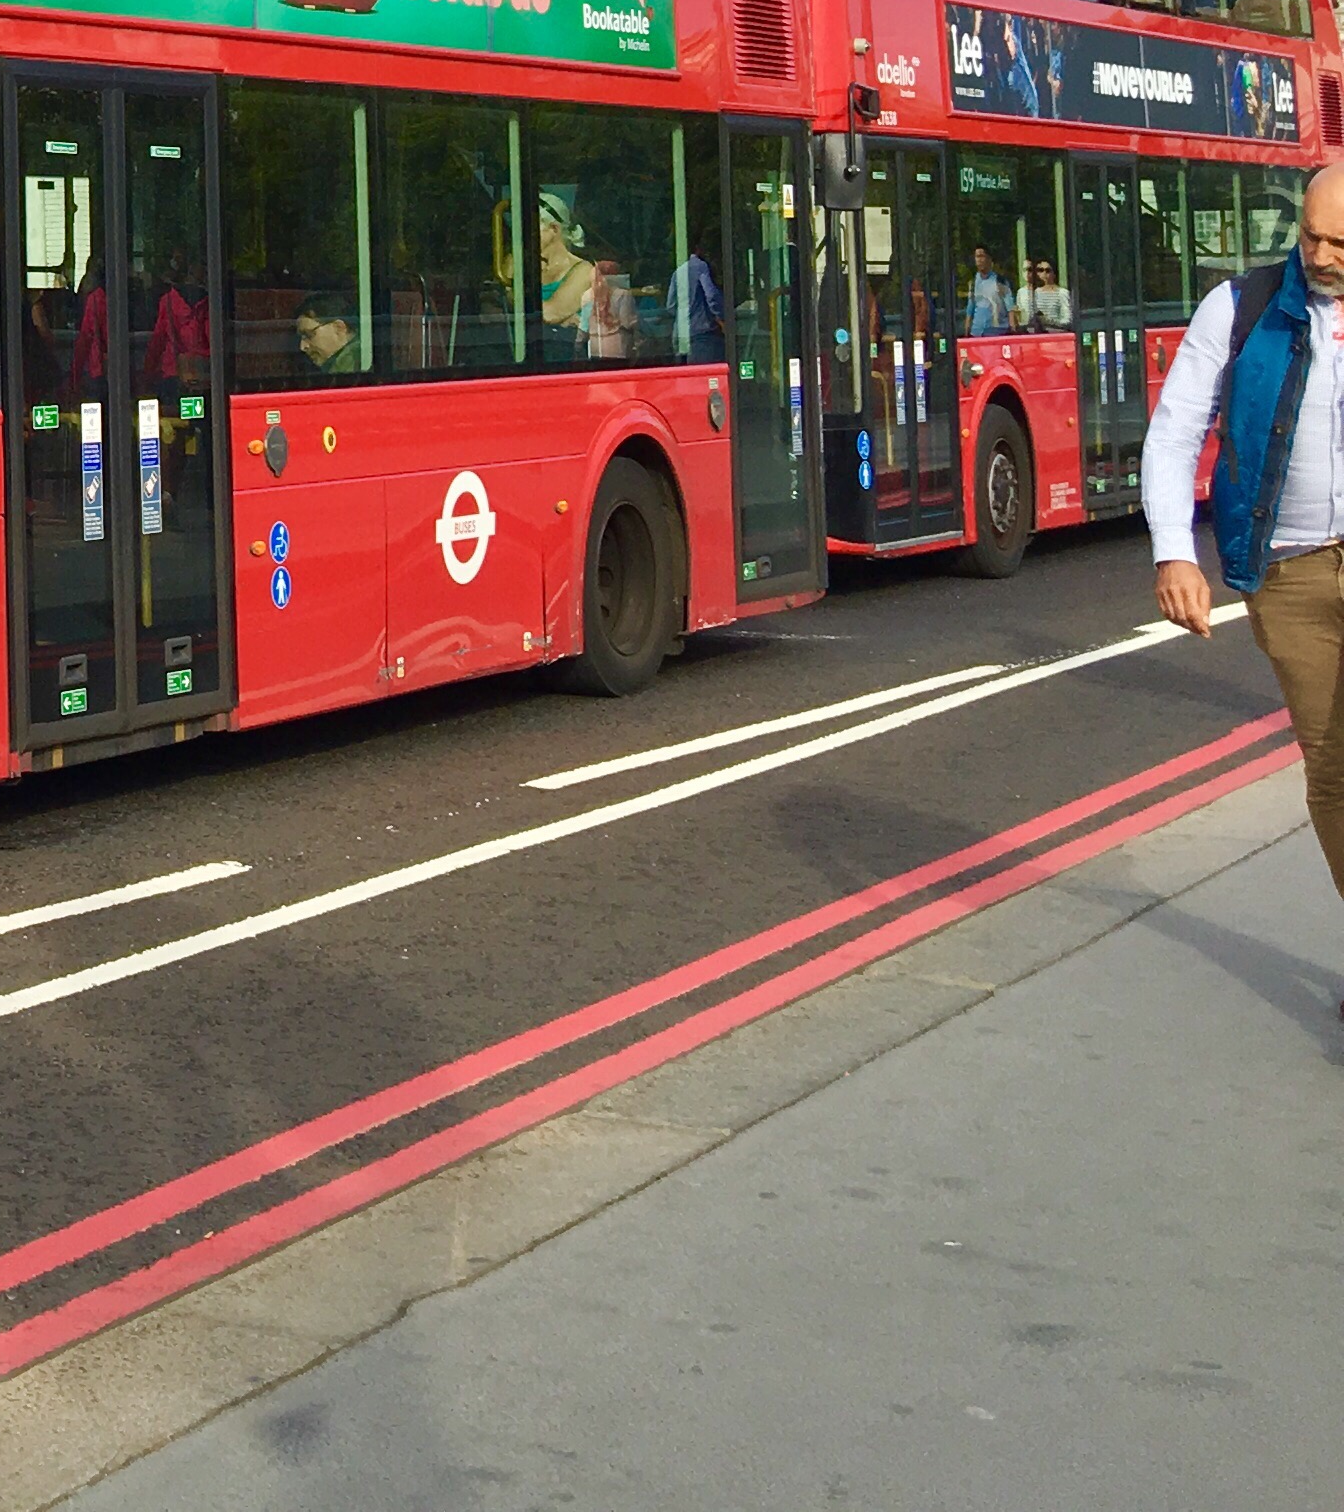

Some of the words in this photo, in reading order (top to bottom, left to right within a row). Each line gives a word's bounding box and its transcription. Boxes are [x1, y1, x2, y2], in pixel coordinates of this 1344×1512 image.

[582, 2, 650, 35] Bookatable
[951, 23, 983, 78] Lee
[877, 53, 915, 86] abellio
[1271, 72, 1294, 114] Lee
[960, 167, 974, 194] 159
[454, 519, 476, 535] BUSES
